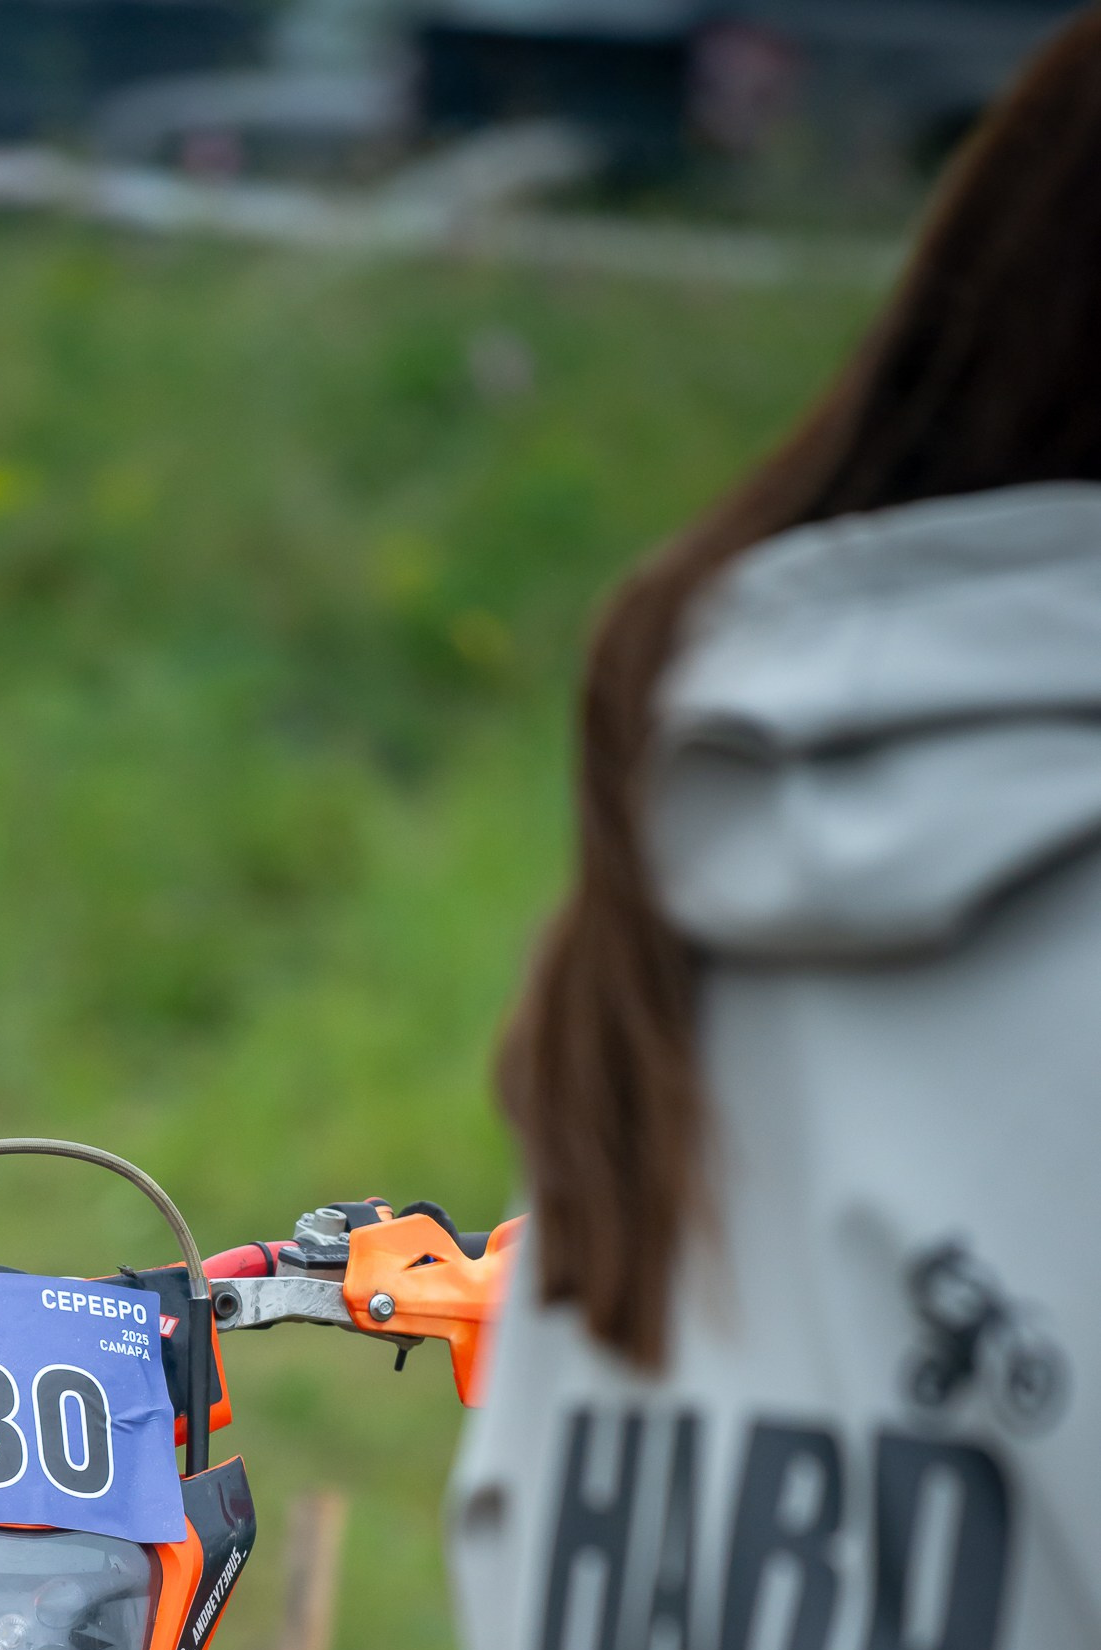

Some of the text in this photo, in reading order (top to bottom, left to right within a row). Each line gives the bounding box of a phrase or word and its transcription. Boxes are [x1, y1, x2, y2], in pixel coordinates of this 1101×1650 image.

[41, 1288, 148, 1325] СЕРЕБРО
[121, 1329, 150, 1346] 2025
[99, 1339, 151, 1362] САМАРА
